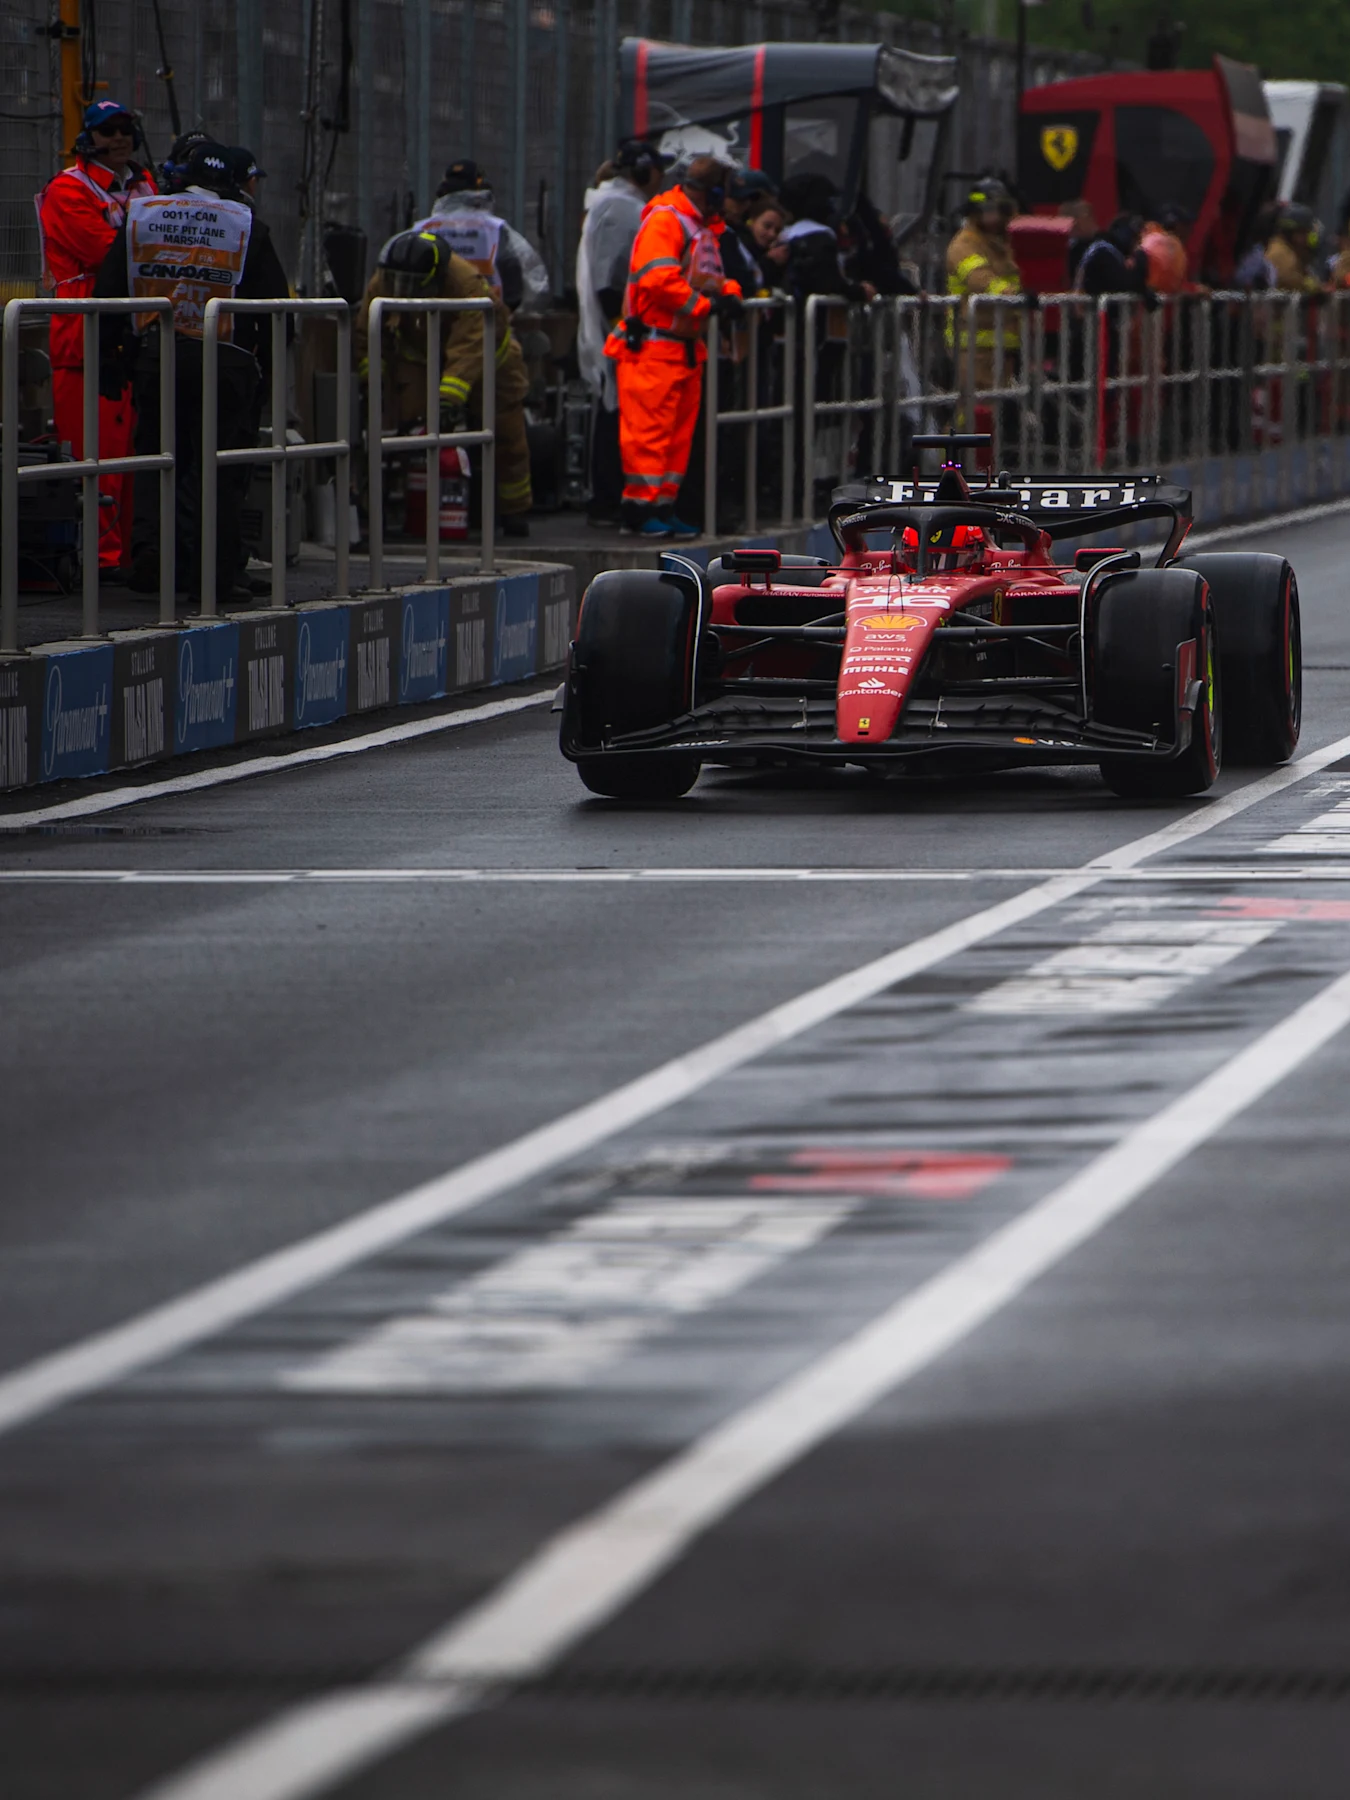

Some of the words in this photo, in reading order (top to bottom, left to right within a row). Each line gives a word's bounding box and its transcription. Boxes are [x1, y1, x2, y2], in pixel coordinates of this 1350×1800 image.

[162, 210, 218, 223] 0011-CAN
[149, 223, 179, 234] CHIEF
[181, 224, 198, 235] PIT
[199, 227, 226, 239] LANE
[163, 234, 212, 247] MARSHAL
[172, 282, 211, 302] PIT
[848, 595, 951, 611] 16
[864, 633, 907, 641] aws
[845, 655, 913, 663] PIRELLI
[843, 666, 909, 676] MAHLE
[838, 688, 904, 700] Santander
[44, 664, 108, 777] Paramount+
